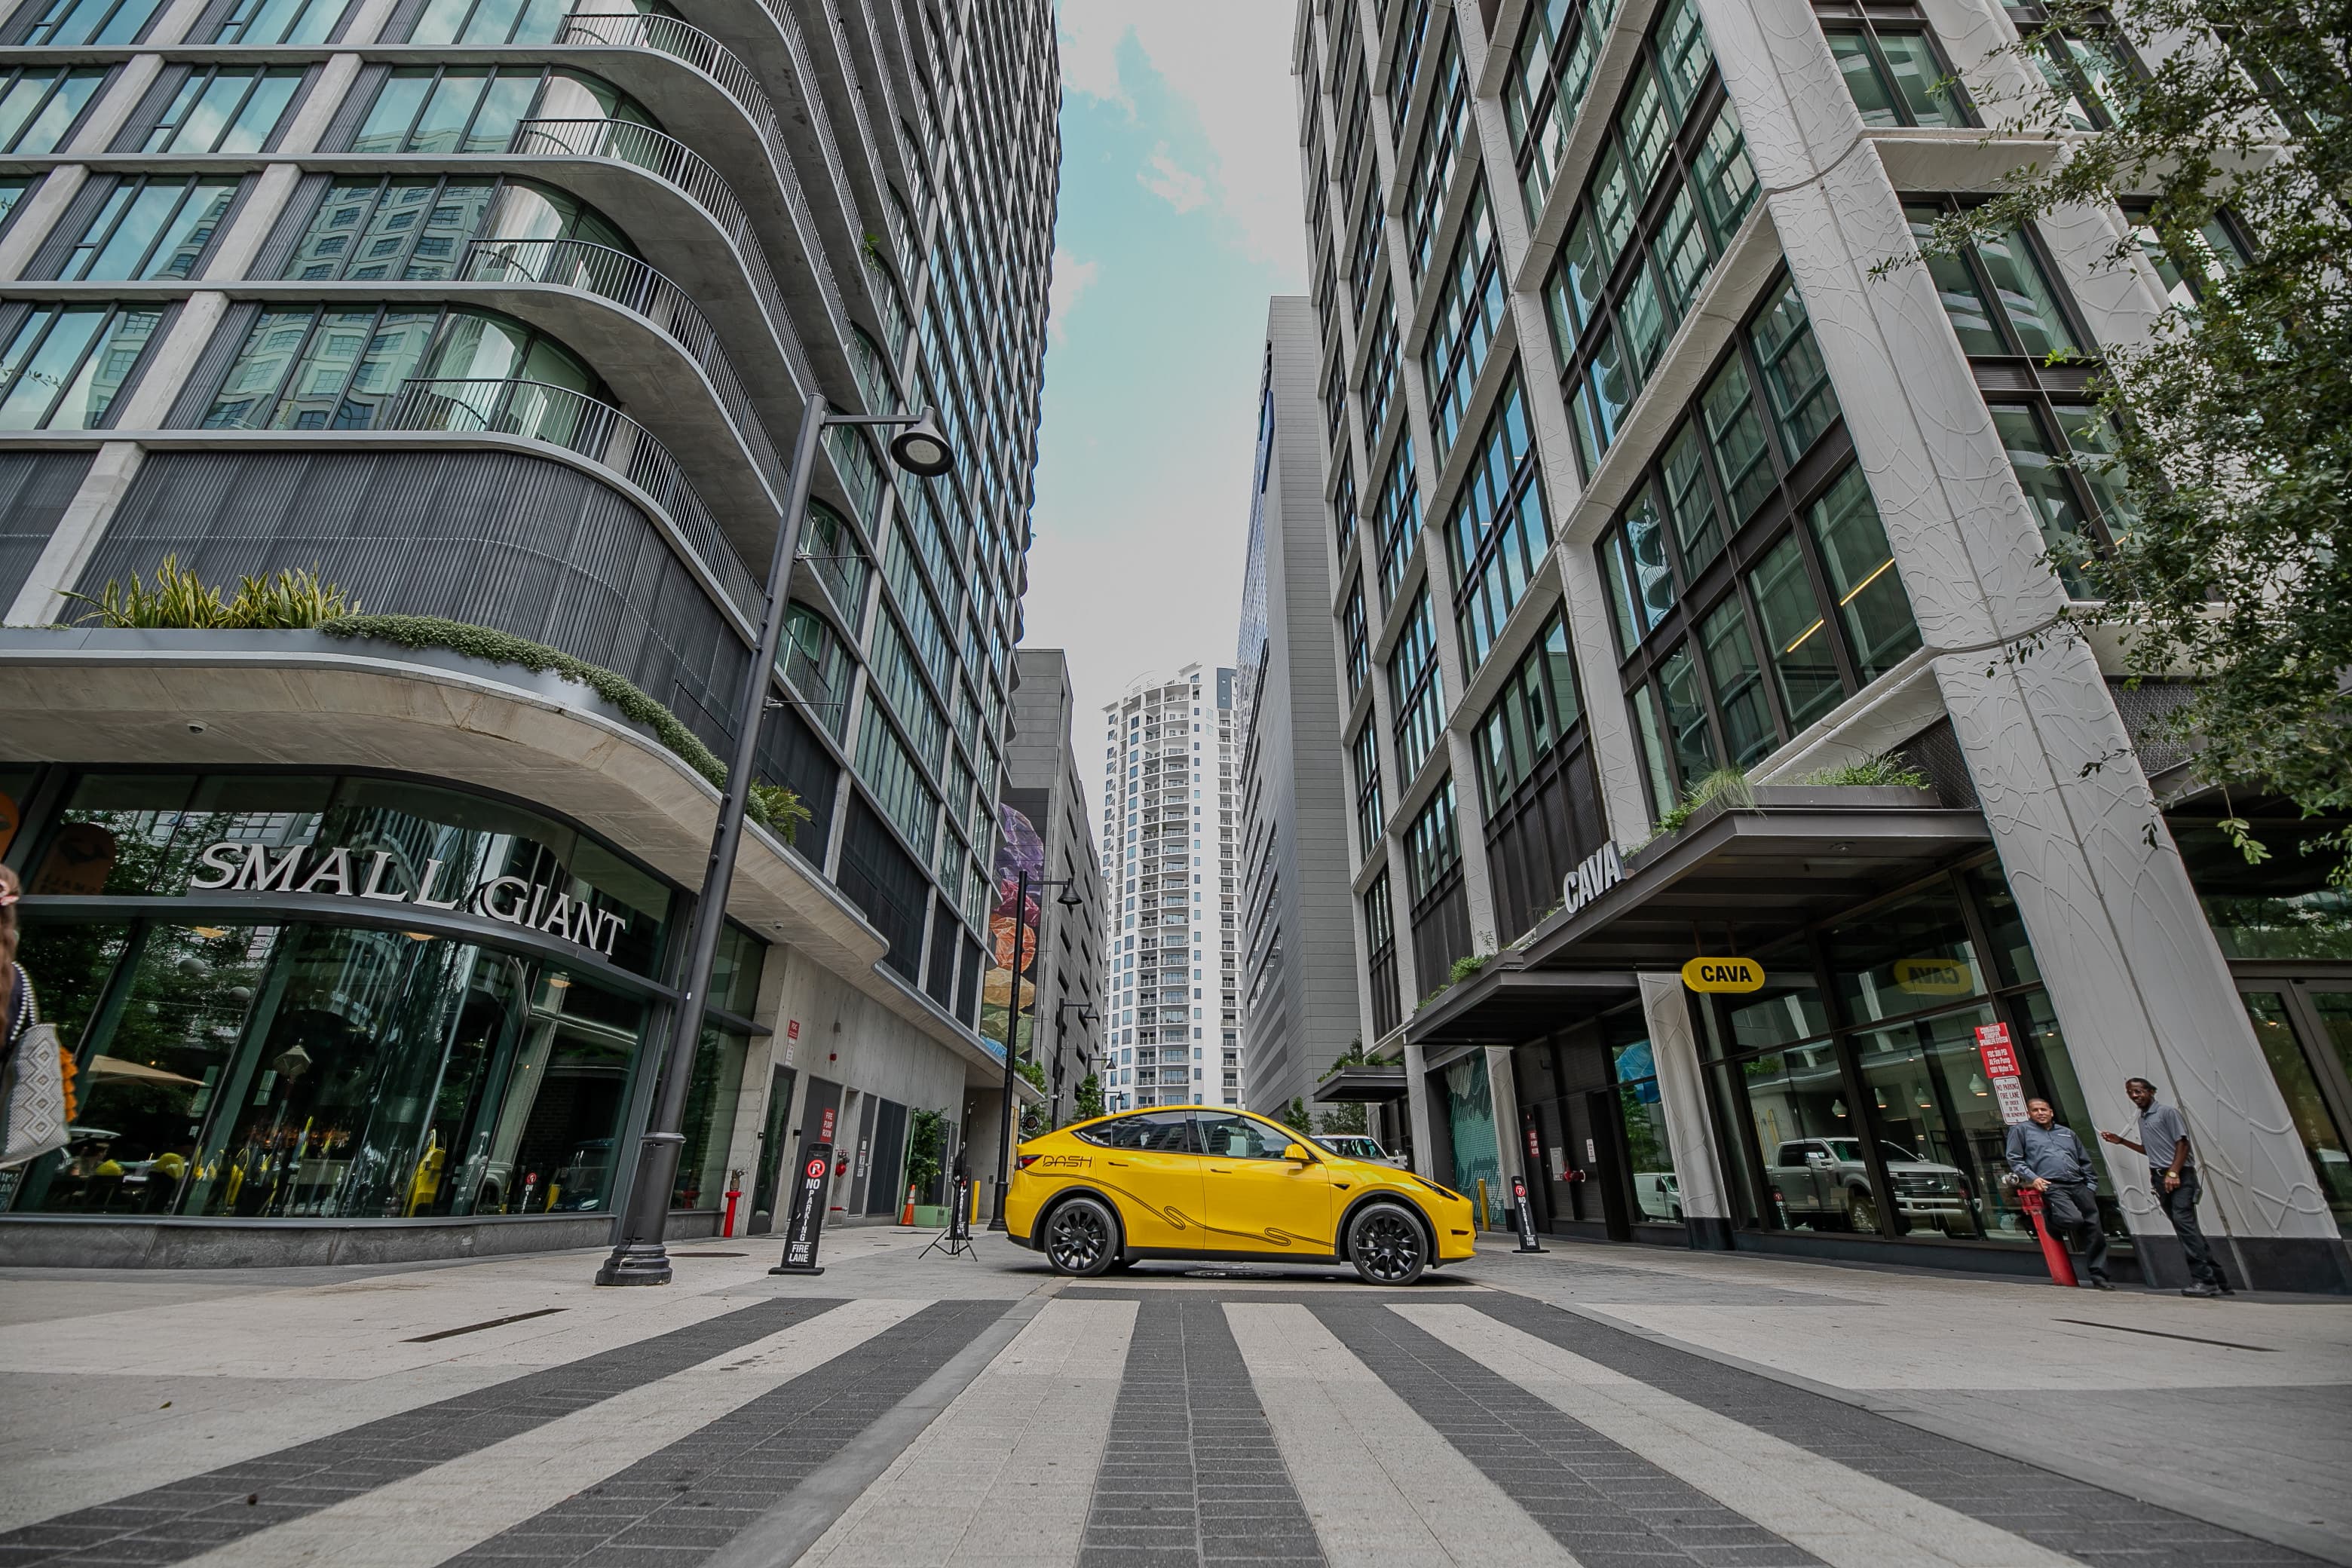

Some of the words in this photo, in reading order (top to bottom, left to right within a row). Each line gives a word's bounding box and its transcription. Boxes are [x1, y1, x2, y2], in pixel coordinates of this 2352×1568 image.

[1563, 839, 1626, 914] CAVA
[191, 842, 459, 910] SMALL
[483, 875, 626, 957] GIANT
[1700, 965, 1753, 984] CAVA
[2003, 1083, 2020, 1091] PARKING
[2009, 1091, 2020, 1099] LANE
[1043, 1155, 1093, 1168] DASH
[806, 1178, 821, 1190] NO
[799, 1190, 815, 1242] PARKING
[792, 1244, 810, 1253] FIRE
[789, 1253, 809, 1263] LANE
